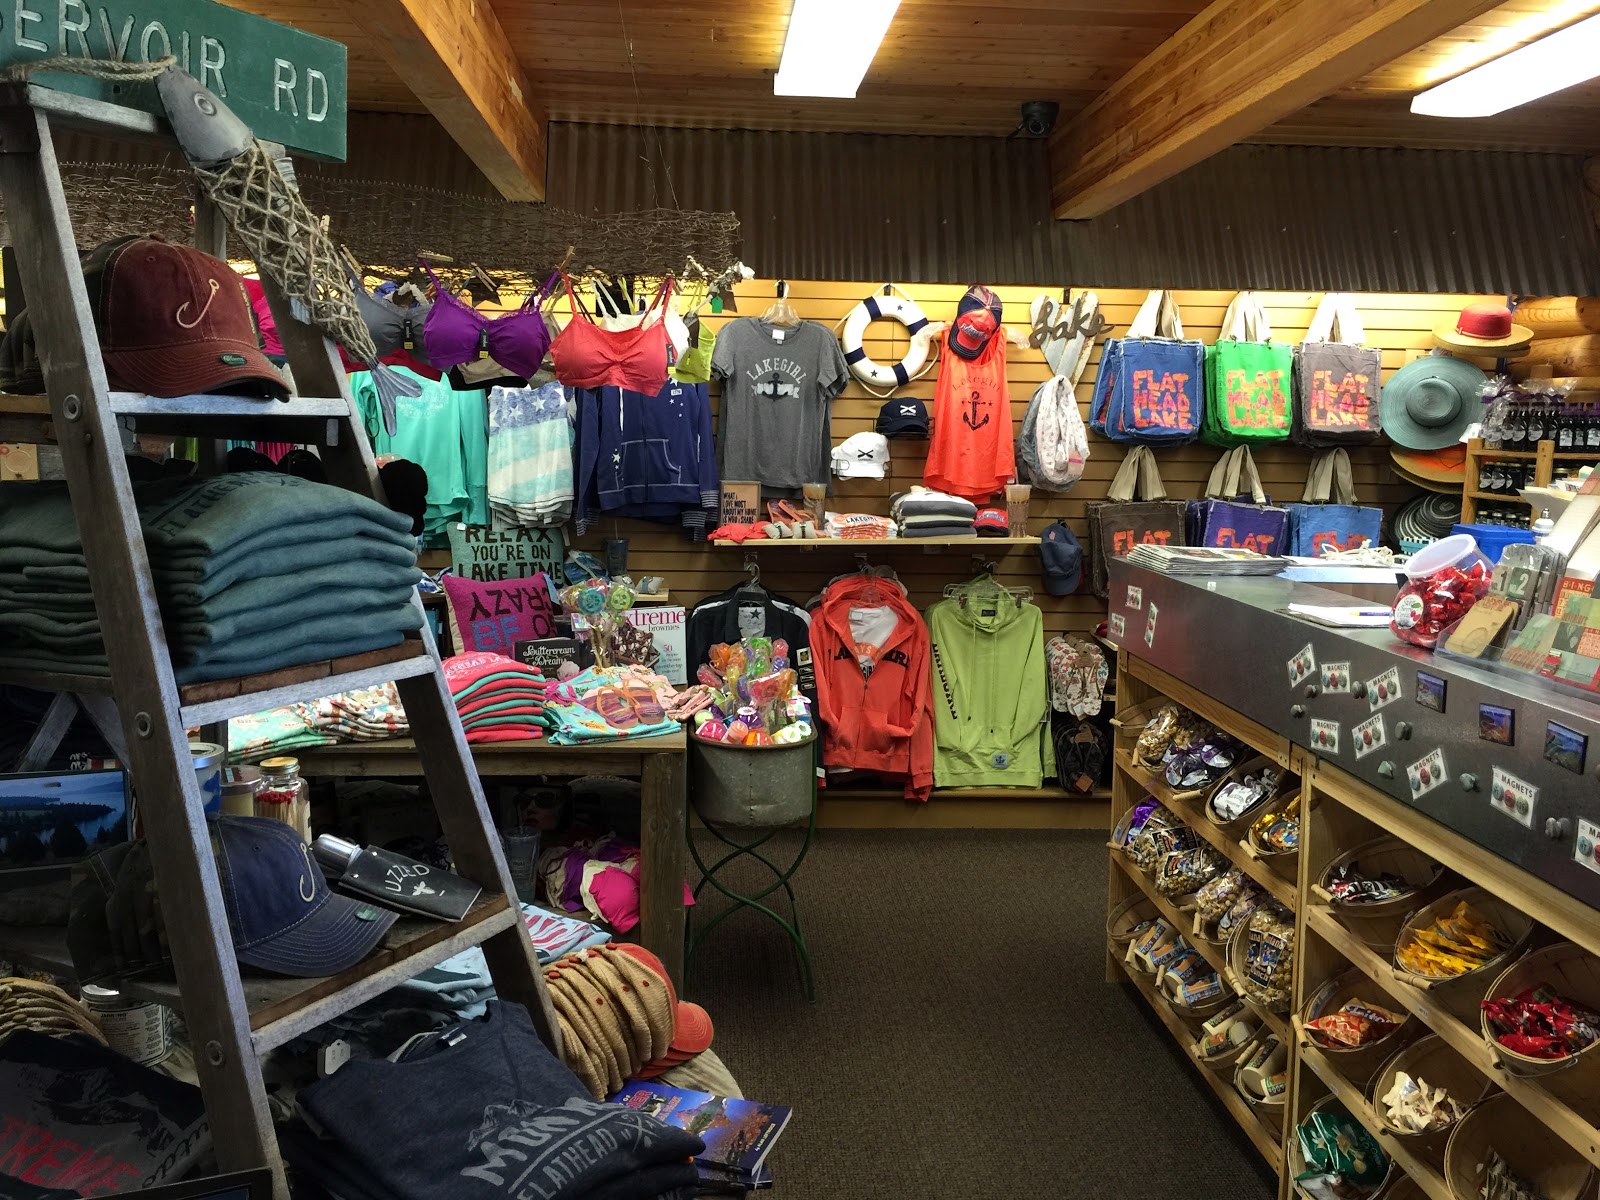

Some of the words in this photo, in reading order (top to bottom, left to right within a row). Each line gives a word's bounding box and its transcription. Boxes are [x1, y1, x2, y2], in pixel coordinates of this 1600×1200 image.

[0, 0, 227, 98] ERVOIR
[274, 57, 329, 122] RD
[746, 357, 807, 384] LAKEGIRL
[1133, 370, 1189, 392] FLAT
[1226, 369, 1285, 391] FLAT
[1312, 370, 1369, 393] FLAT
[1134, 390, 1190, 412] HEAD
[1226, 388, 1287, 410] HEAD
[1311, 390, 1370, 412] HEAD
[1134, 409, 1194, 431] LAKE
[1226, 405, 1289, 428] LAKE
[1310, 407, 1370, 430] LAKE
[465, 525, 553, 543] RELAX
[1217, 528, 1275, 555] FLAT
[471, 543, 525, 561] YOU'RE
[531, 543, 552, 560] ON
[458, 562, 509, 580] LAKE
[1500, 570, 1508, 592] 1
[1518, 572, 1530, 595] 2
[626, 609, 686, 627] xtreme
[523, 645, 576, 657] Buttercream
[663, 644, 673, 653] 50
[1327, 663, 1349, 672] MAGNETS
[1372, 668, 1397, 687] MAGNETS
[1316, 721, 1337, 731] MAGNETS
[1357, 715, 1381, 733] MAGNETS
[1413, 752, 1440, 772] MAGNETS
[1501, 774, 1533, 799] MAGNETS
[385, 865, 430, 893] UZZED
[0, 1115, 142, 1198] TREME
[517, 1127, 619, 1200] FLATHEAD
